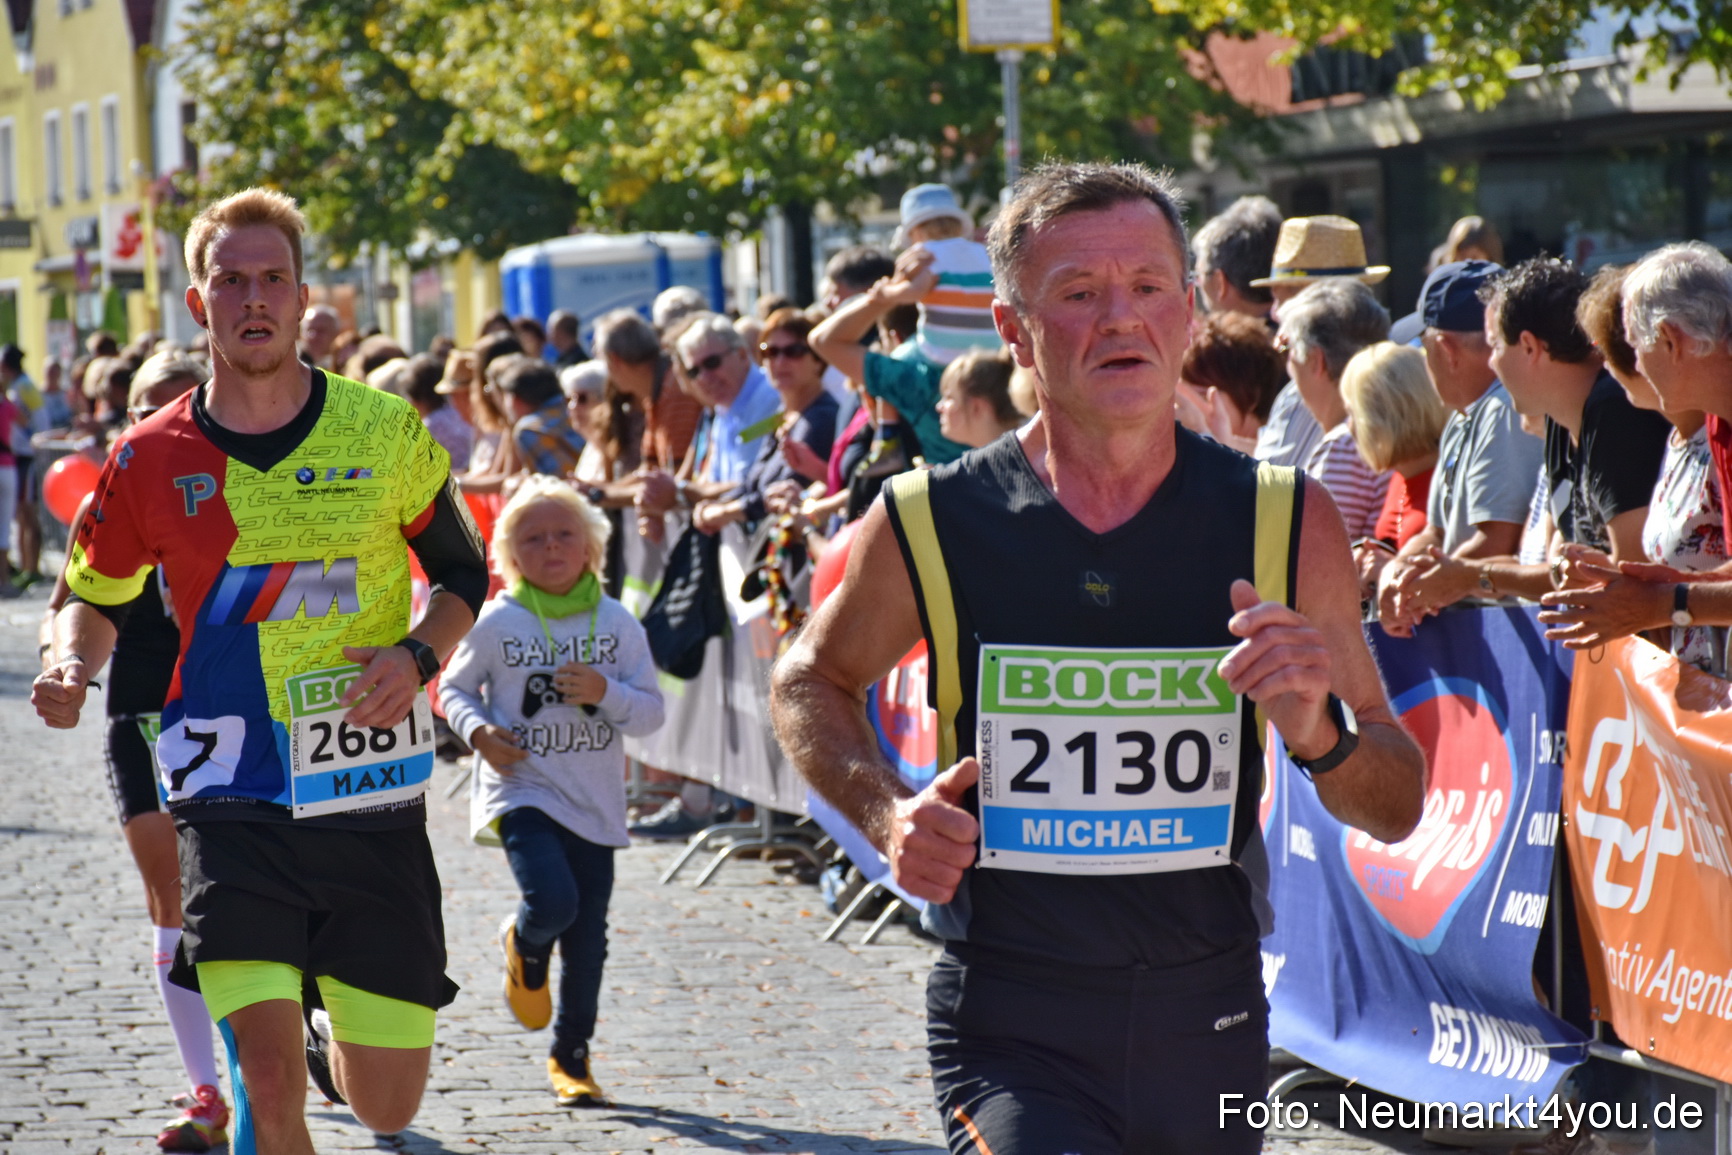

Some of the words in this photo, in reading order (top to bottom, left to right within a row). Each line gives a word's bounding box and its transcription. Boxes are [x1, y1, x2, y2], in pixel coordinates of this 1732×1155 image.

[500, 634, 619, 667] GAMER
[1003, 661, 1214, 703] BOCK
[309, 708, 418, 764] 2681
[511, 720, 614, 757] SQUAD
[170, 725, 218, 792] 7
[1009, 728, 1212, 796] 2130
[333, 764, 405, 796] MAXI
[1021, 817, 1195, 848] MICHAEL
[1363, 863, 1408, 902] SPORTS
[1428, 1001, 1470, 1070] GET
